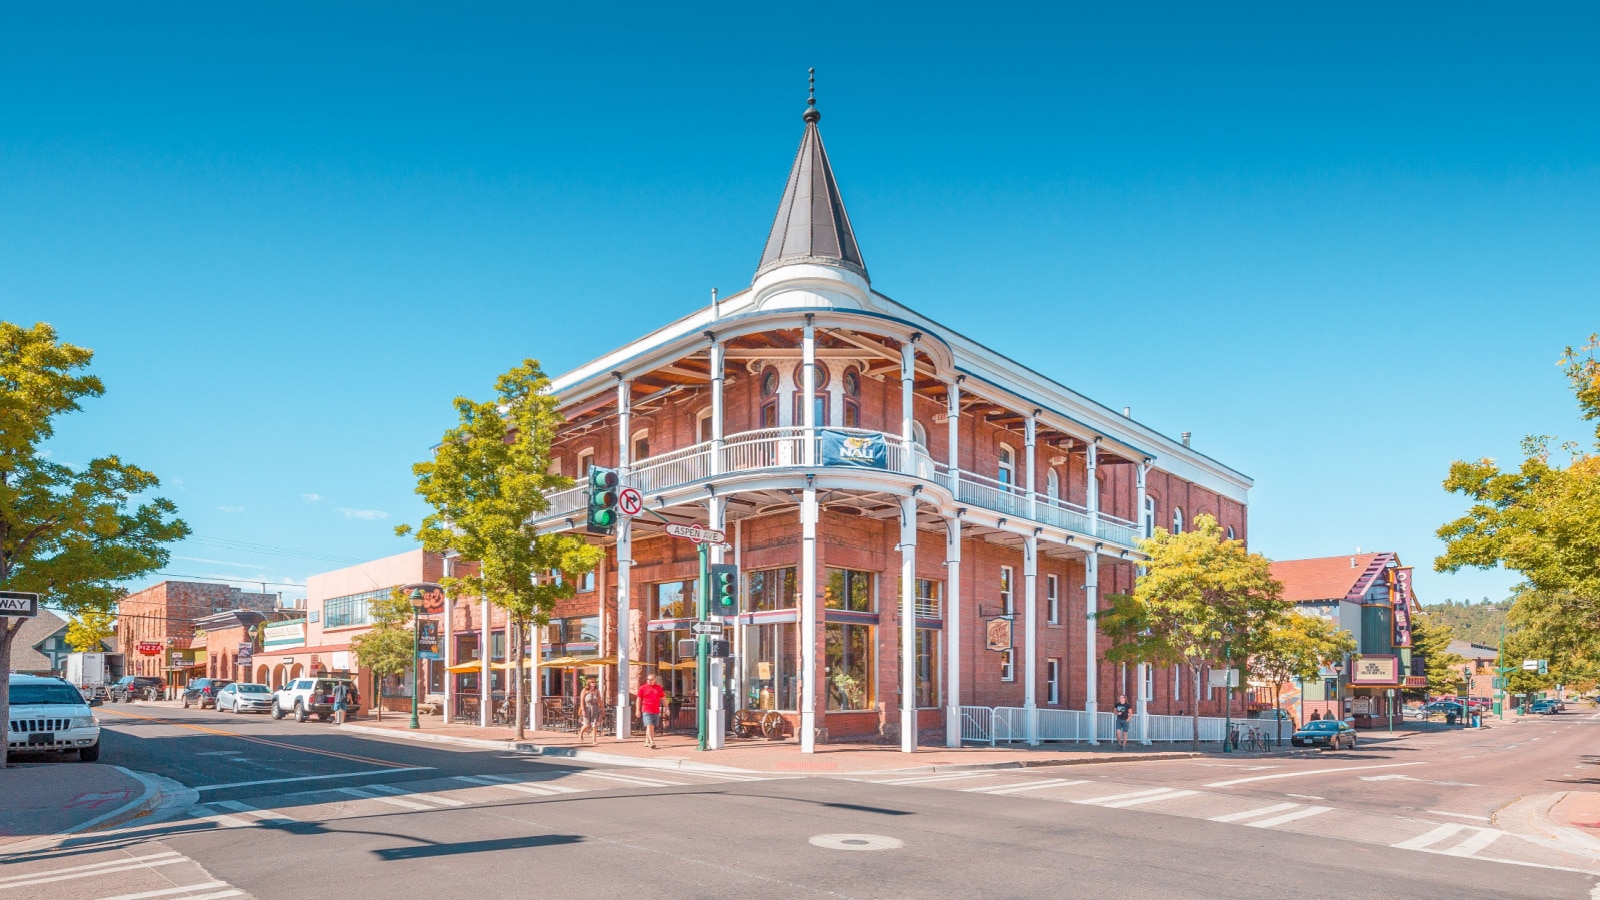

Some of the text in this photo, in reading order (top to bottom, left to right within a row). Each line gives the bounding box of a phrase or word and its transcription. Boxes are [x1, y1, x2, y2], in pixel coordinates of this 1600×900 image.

[840, 447, 874, 459] NAU
[674, 526, 718, 541] ASPEN AVE
[0, 599, 26, 609] WAY
[1396, 572, 1407, 643] ORPHEUM
